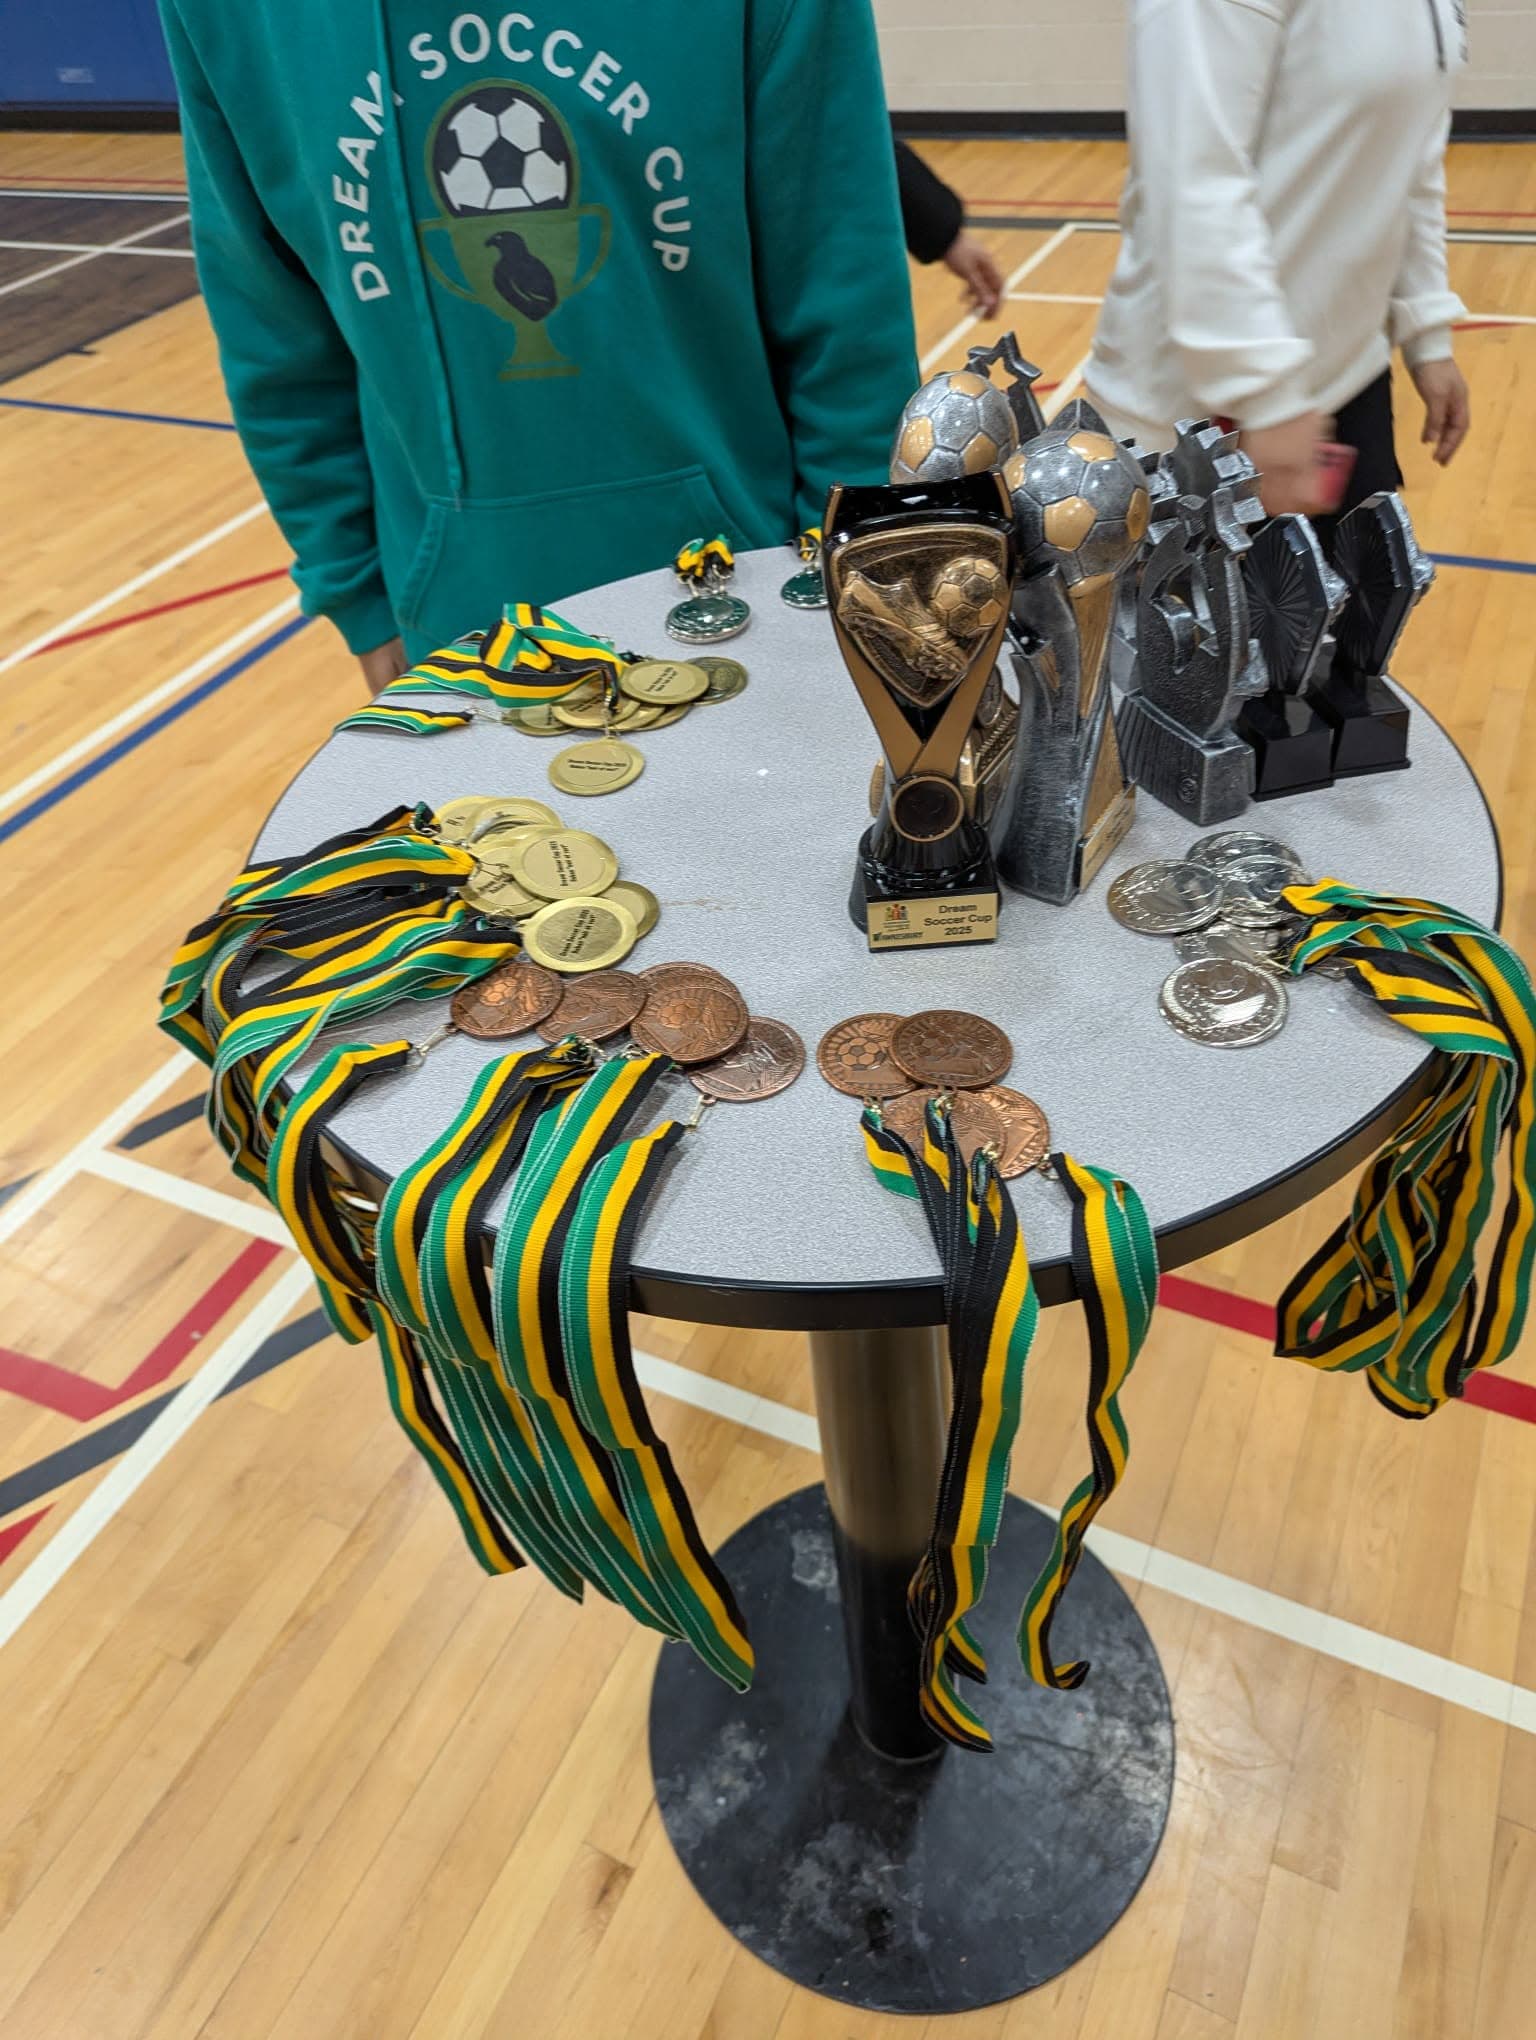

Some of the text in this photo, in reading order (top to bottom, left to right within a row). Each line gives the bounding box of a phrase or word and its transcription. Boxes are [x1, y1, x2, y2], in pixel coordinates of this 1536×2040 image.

[408, 13, 651, 135] SOCCER
[645, 146, 691, 271] CUP
[938, 904, 977, 914] Dream
[923, 914, 993, 927] Soccer Cup
[944, 926, 973, 936] 2025
